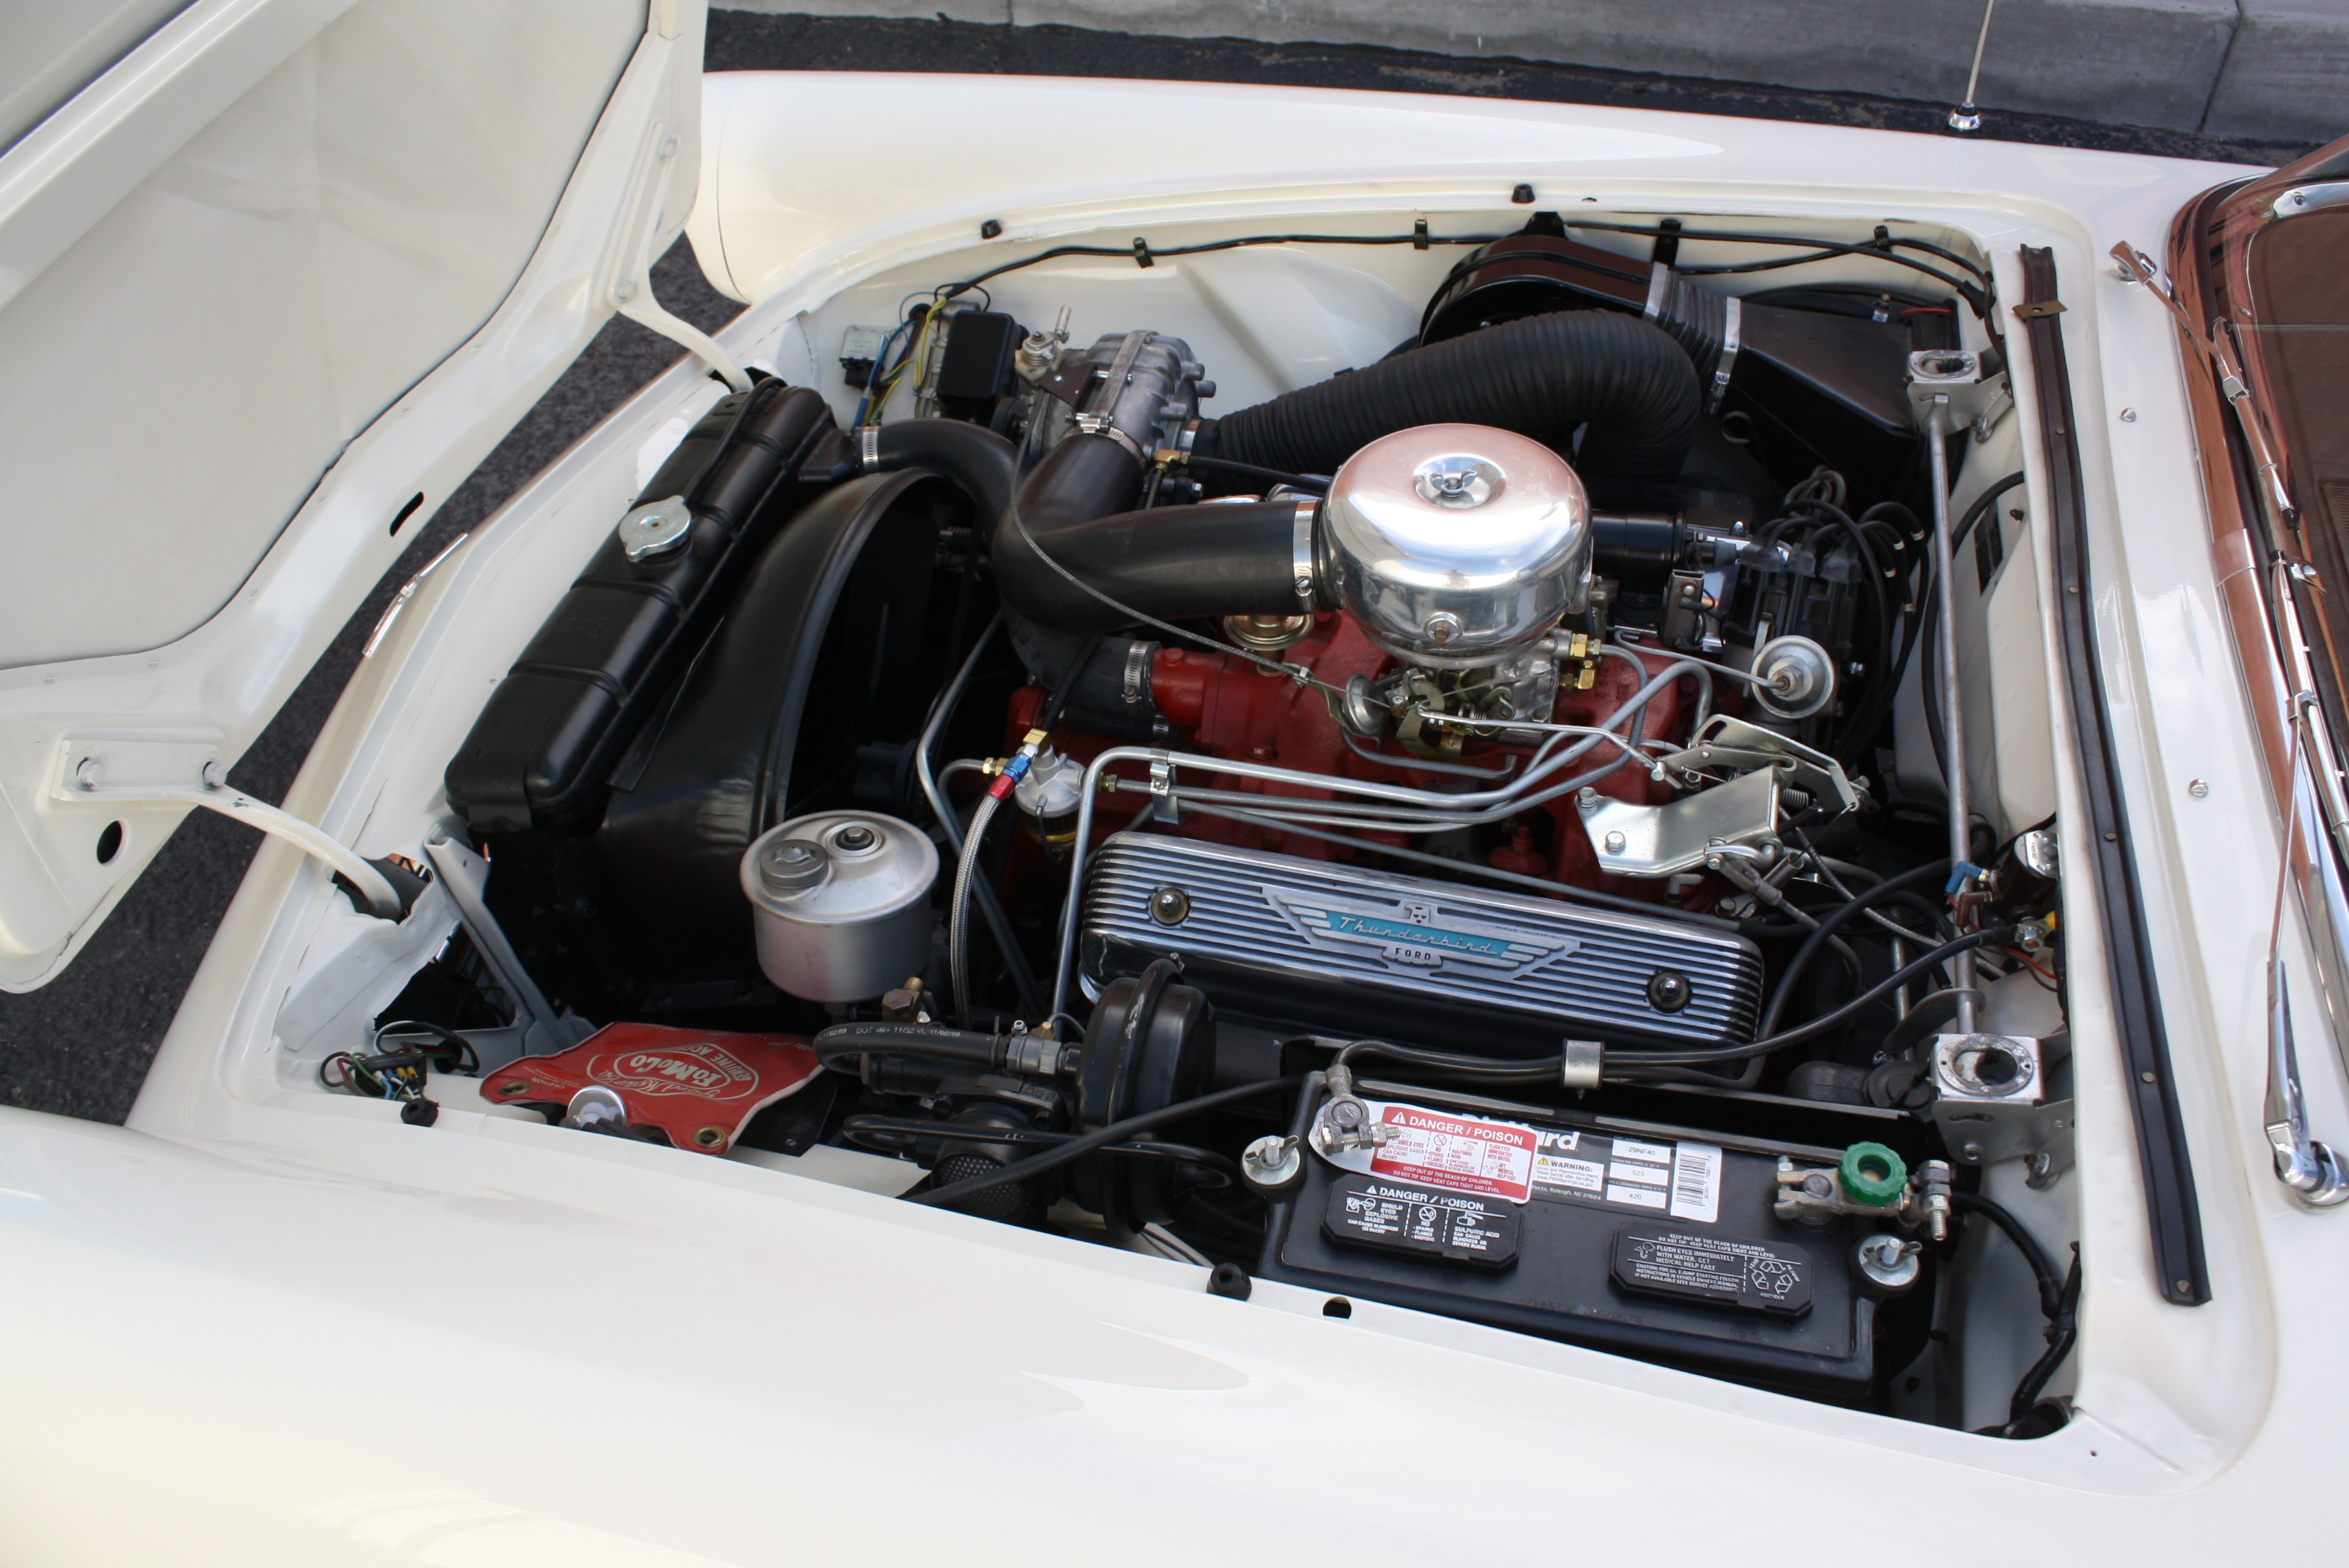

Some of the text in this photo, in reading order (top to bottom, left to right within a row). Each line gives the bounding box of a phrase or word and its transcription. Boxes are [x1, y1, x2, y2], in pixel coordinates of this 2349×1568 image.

[1340, 916, 1497, 956] Thunderbird
[1395, 947, 1431, 961] FORD
[630, 1054, 722, 1087] FoMoCo
[710, 1053, 752, 1081] GENUINE
[531, 1076, 566, 1089] CAUTION
[1409, 1116, 1464, 1134] DANGER
[1466, 1126, 1471, 1135] /
[1473, 1128, 1523, 1145] POISON
[1628, 1146, 1655, 1155] 29NF40
[1379, 1187, 1484, 1211] DANGER / POISON
[1381, 1202, 1403, 1210] SHIELD
[1364, 1215, 1385, 1224] GASES
[1365, 1210, 1398, 1221] EXPLOSIVE
[1454, 1225, 1484, 1235] SULFURIC
[1655, 1257, 1683, 1265] MEDICAL
[1693, 1250, 1734, 1262] IMMEDIATELY
[1635, 1268, 1669, 1277] INSTRUCTIONS
[1695, 1272, 1718, 1280] STARTING
